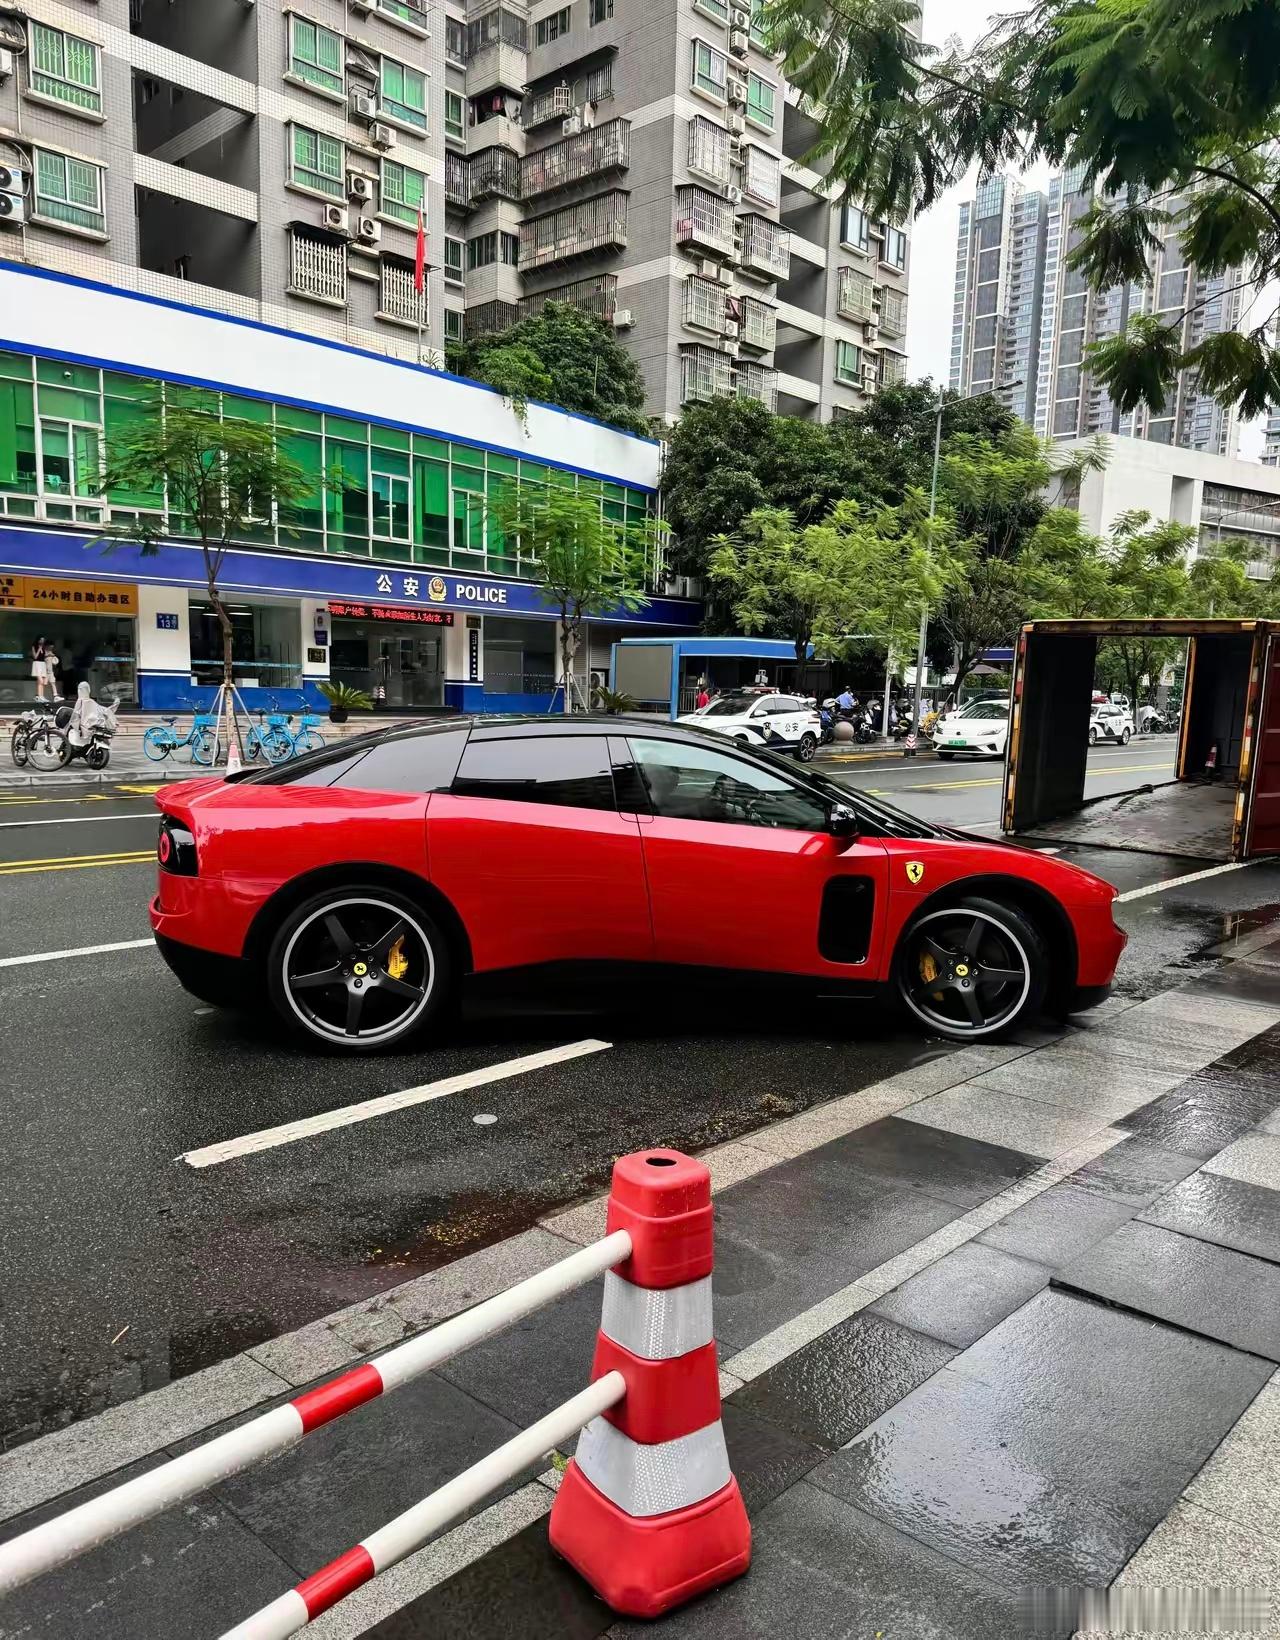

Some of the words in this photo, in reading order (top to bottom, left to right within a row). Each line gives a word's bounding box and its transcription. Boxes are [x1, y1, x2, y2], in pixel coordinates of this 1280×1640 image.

[376, 574, 419, 597] 公安
[456, 584, 507, 604] POLICE
[32, 589, 129, 605] 24小时自助办理区
[785, 722, 799, 732] 公安
